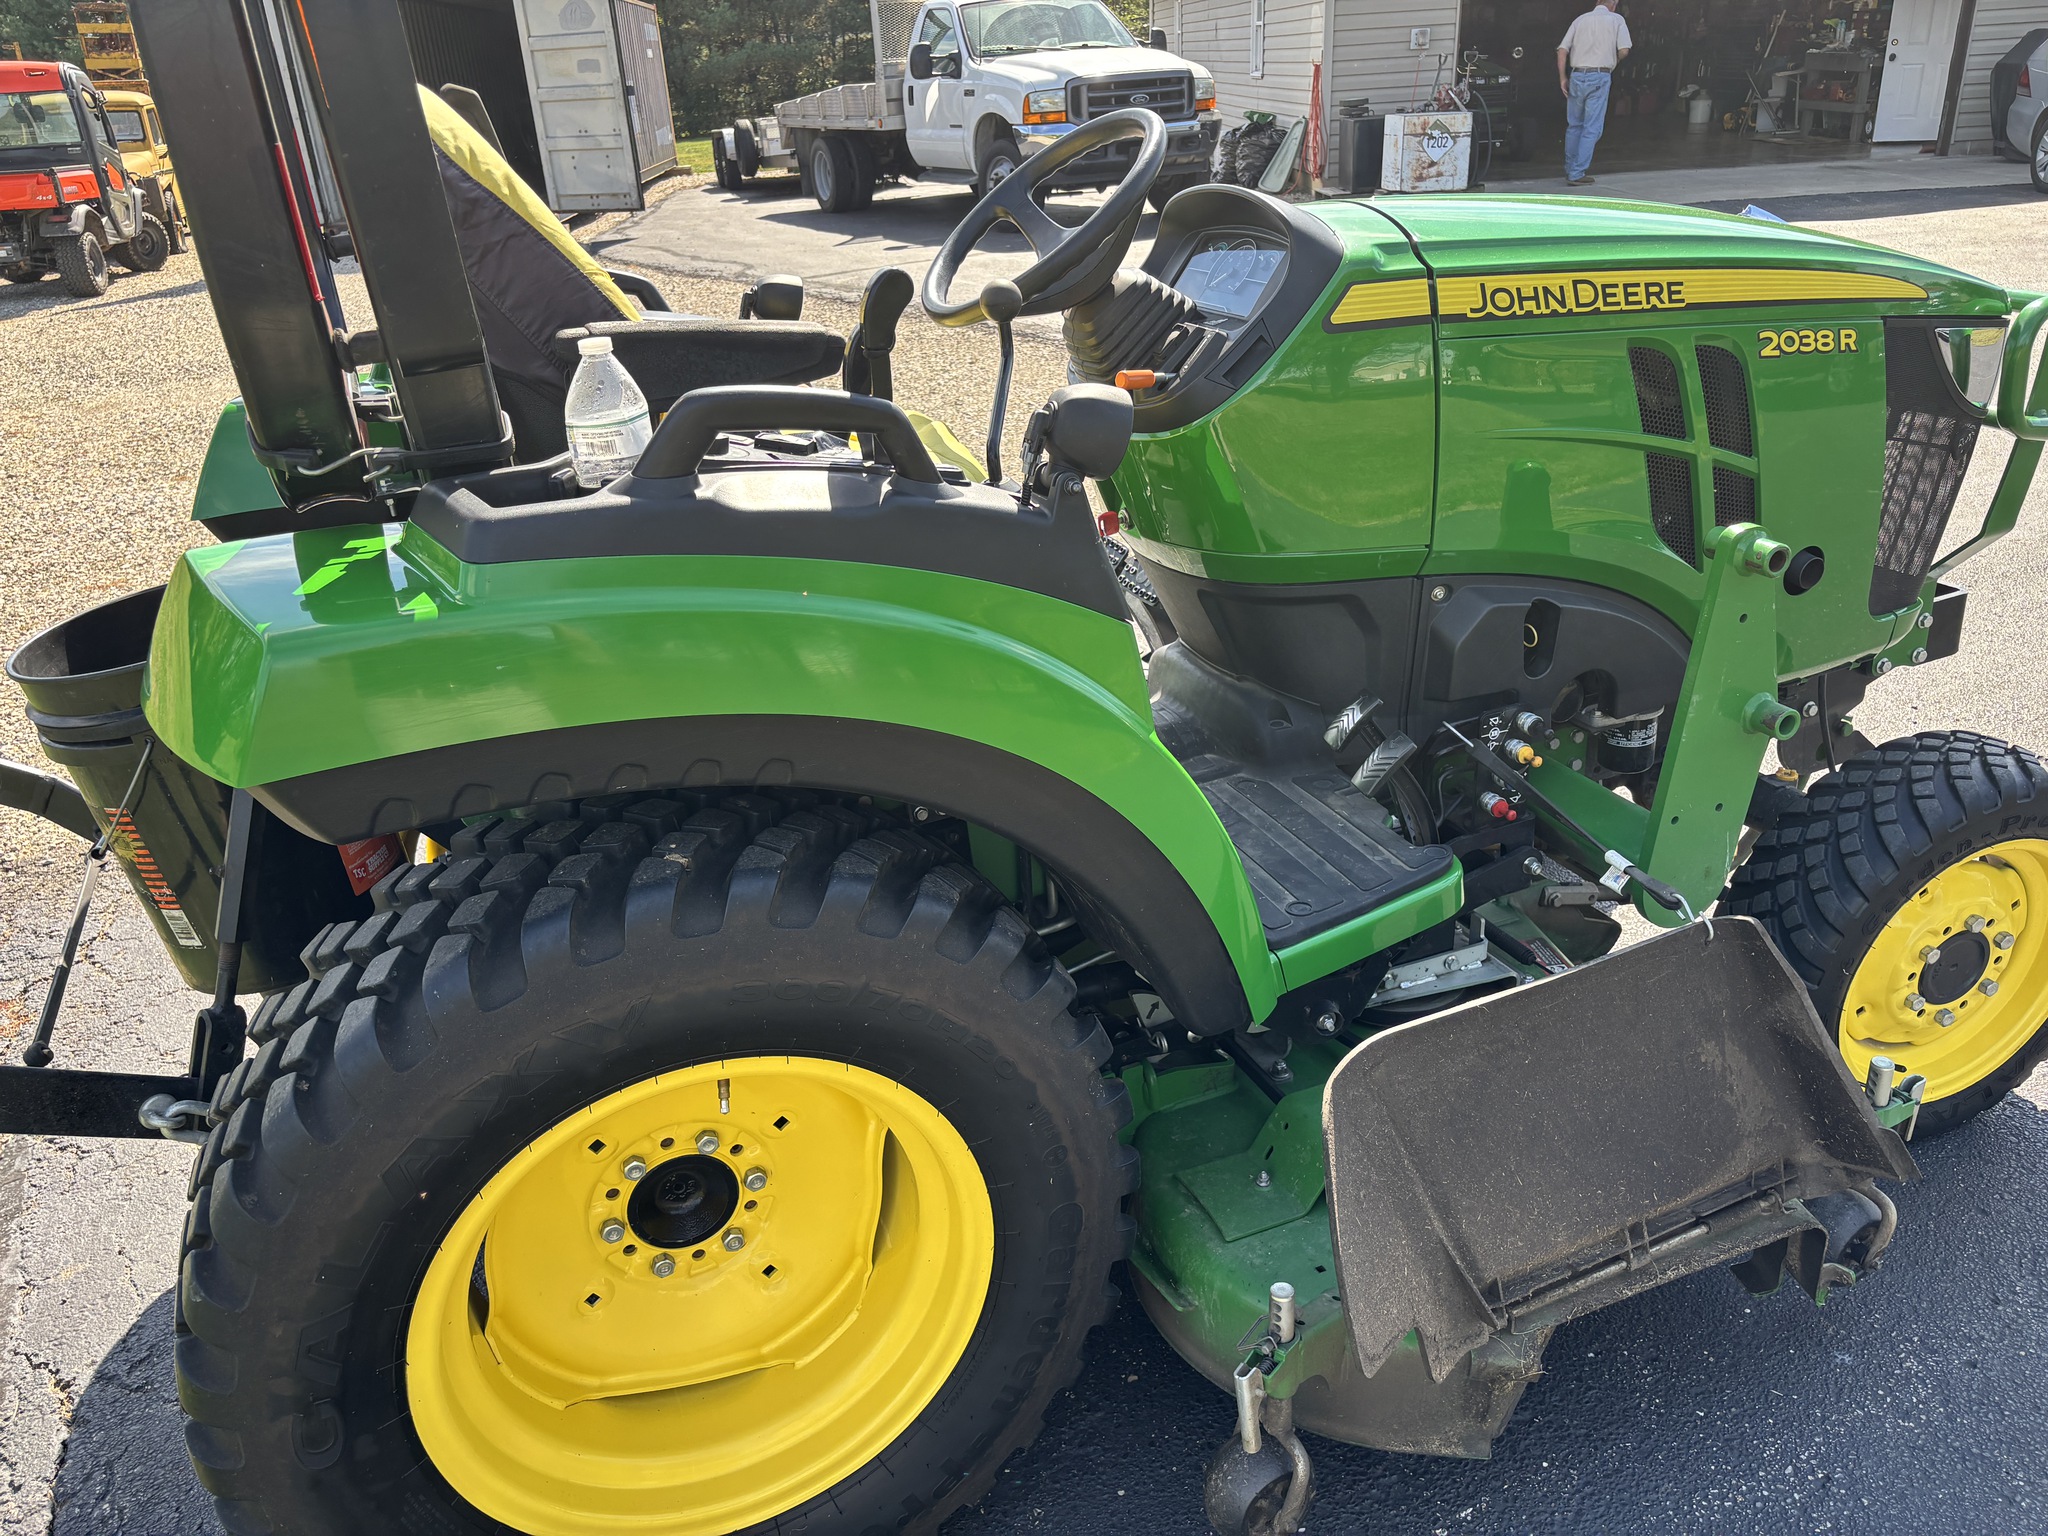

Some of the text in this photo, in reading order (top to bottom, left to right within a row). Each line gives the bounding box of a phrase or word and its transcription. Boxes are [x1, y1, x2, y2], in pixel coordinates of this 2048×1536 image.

[1426, 136, 1449, 149] 1202
[1469, 279, 1686, 314] JOHN DEERE
[1758, 329, 1836, 359] 2038
[352, 867, 367, 879] TSC
